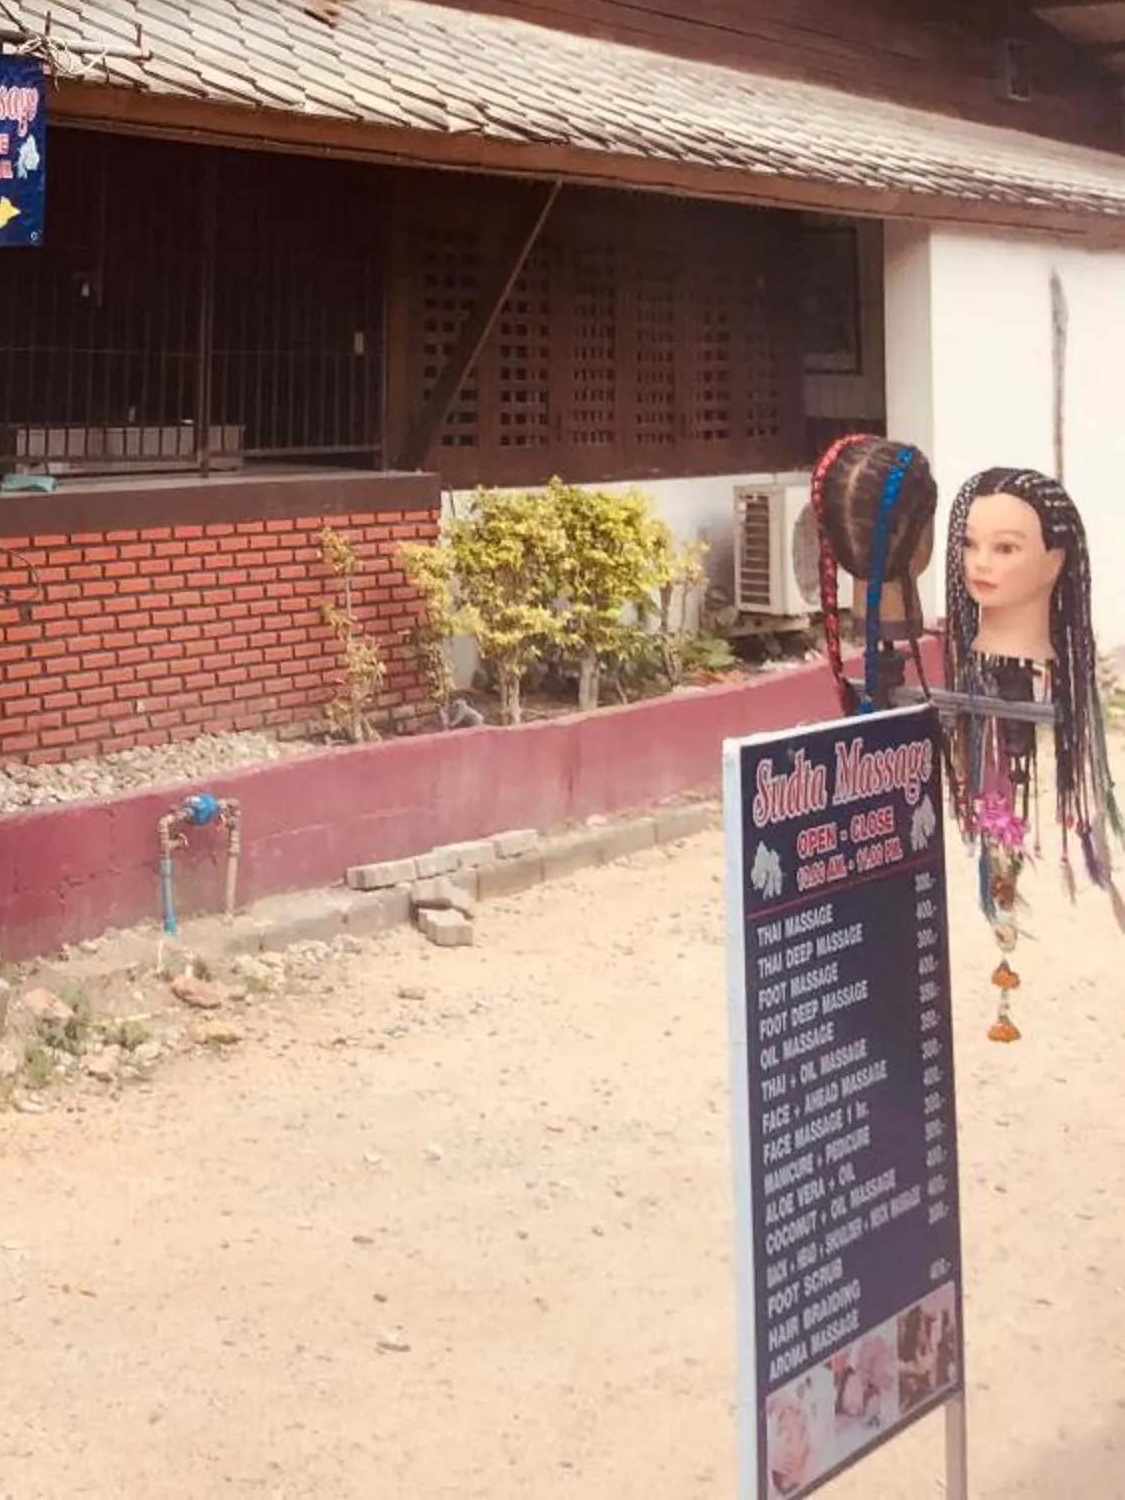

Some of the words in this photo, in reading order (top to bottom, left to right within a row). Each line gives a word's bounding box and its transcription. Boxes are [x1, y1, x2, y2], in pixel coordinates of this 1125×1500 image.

[832, 736, 933, 805] Massage
[797, 821, 837, 860] OPEN
[850, 804, 895, 843] CLOSE
[757, 922, 782, 948] THAI
[784, 903, 834, 937] MASSAGE
[758, 953, 783, 979] THAI
[785, 940, 813, 968] DEEP
[816, 923, 863, 957] MASSAGE
[758, 982, 787, 1011] FOOT
[790, 961, 839, 997] MASSAGE
[759, 1012, 787, 1041] FOOT
[791, 999, 819, 1028] DEEP
[822, 980, 869, 1014] MASSAGE
[760, 1045, 780, 1071] OIL
[782, 1021, 834, 1061] MASSAGE
[761, 1073, 786, 1102] THAI
[799, 1060, 818, 1085] OIL
[820, 1037, 868, 1076] MASSAGE
[762, 1103, 790, 1135] FACE
[841, 1059, 888, 1098] MASSAGE
[763, 1132, 792, 1166] FACE
[794, 1107, 843, 1150] MASSAGE
[765, 1191, 794, 1228] ALOE
[796, 1175, 826, 1208] VERA
[838, 1161, 856, 1186] OIL
[765, 1209, 817, 1256] COCONUT
[830, 1194, 847, 1220] OIL
[849, 1167, 896, 1209] MASSAGE
[767, 1280, 800, 1319] FOOT
[803, 1257, 843, 1298] SCRUB
[768, 1315, 799, 1353] HAIR
[768, 1341, 808, 1383] AROMA
[810, 1308, 859, 1357] MASSAGE
